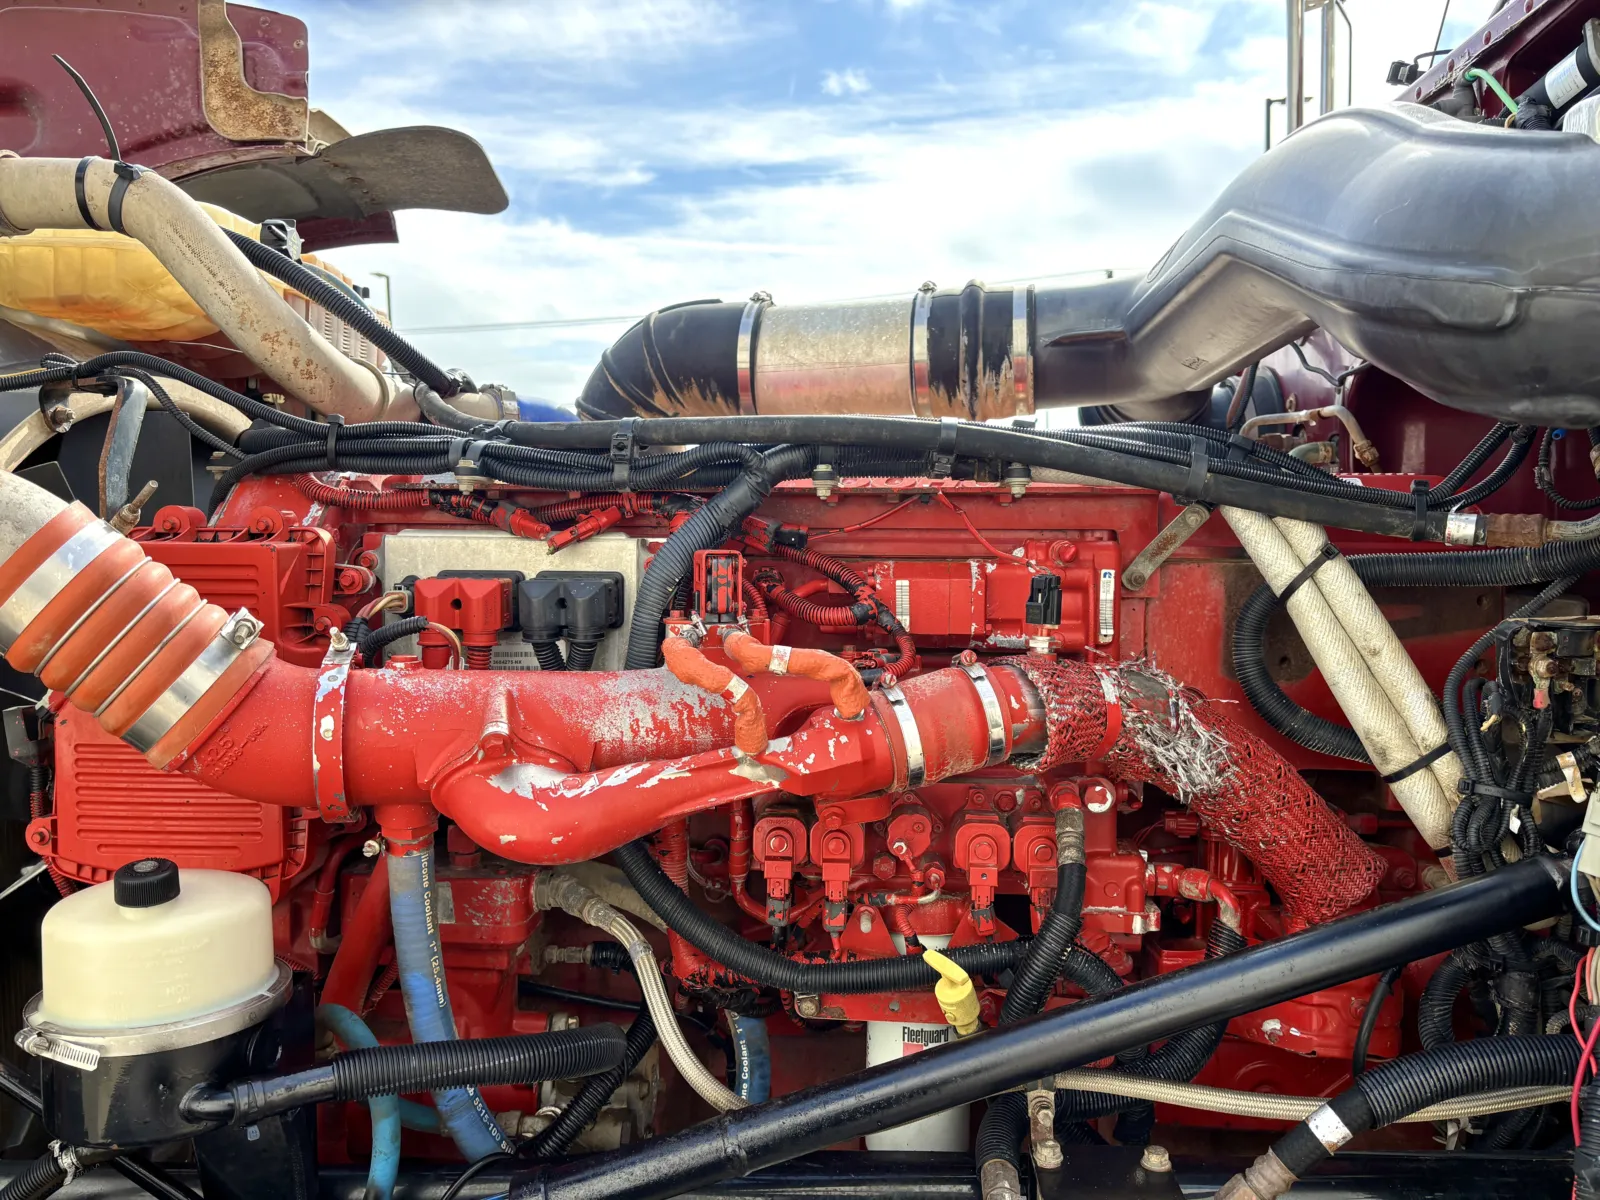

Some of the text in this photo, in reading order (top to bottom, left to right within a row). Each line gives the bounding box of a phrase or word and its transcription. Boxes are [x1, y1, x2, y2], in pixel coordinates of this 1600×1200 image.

[421, 852, 430, 888] licone
[423, 890, 435, 935] Coolant
[430, 955, 447, 1008] (25.4mm)
[902, 1025, 950, 1047] Fleetguard
[739, 1039, 749, 1080] Coolant
[473, 1096, 501, 1142] 5515-100
